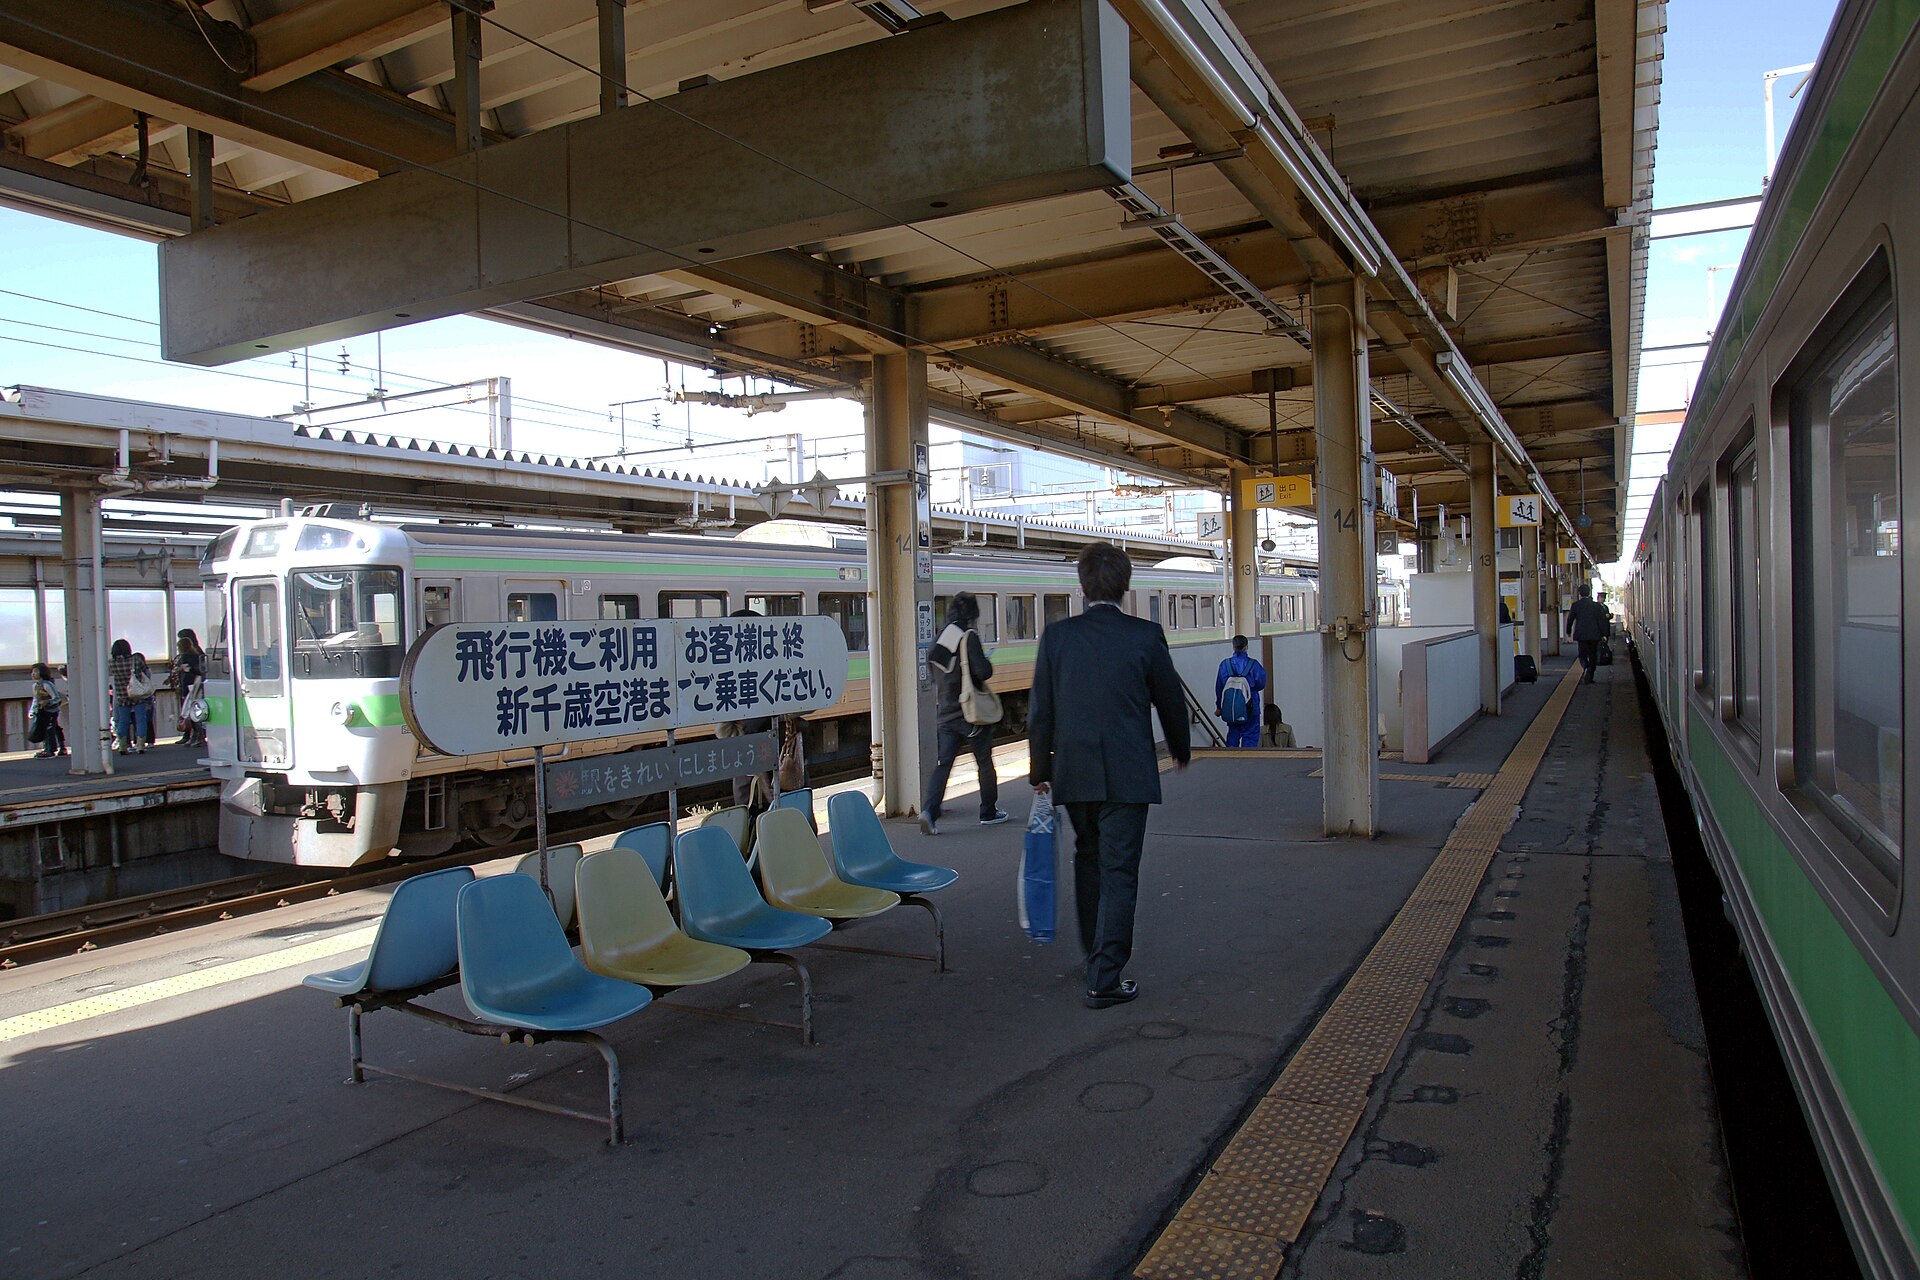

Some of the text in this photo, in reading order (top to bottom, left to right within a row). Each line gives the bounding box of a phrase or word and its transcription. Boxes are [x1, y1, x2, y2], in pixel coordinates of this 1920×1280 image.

[1279, 484, 1296, 492] 出口
[1333, 508, 1357, 533] 14
[896, 534, 912, 555] 14
[1383, 539, 1393, 552] 2
[1479, 554, 1491, 566] 13
[1240, 564, 1252, 576] 13
[455, 622, 804, 683] 飛行機ご利用 お客様は終
